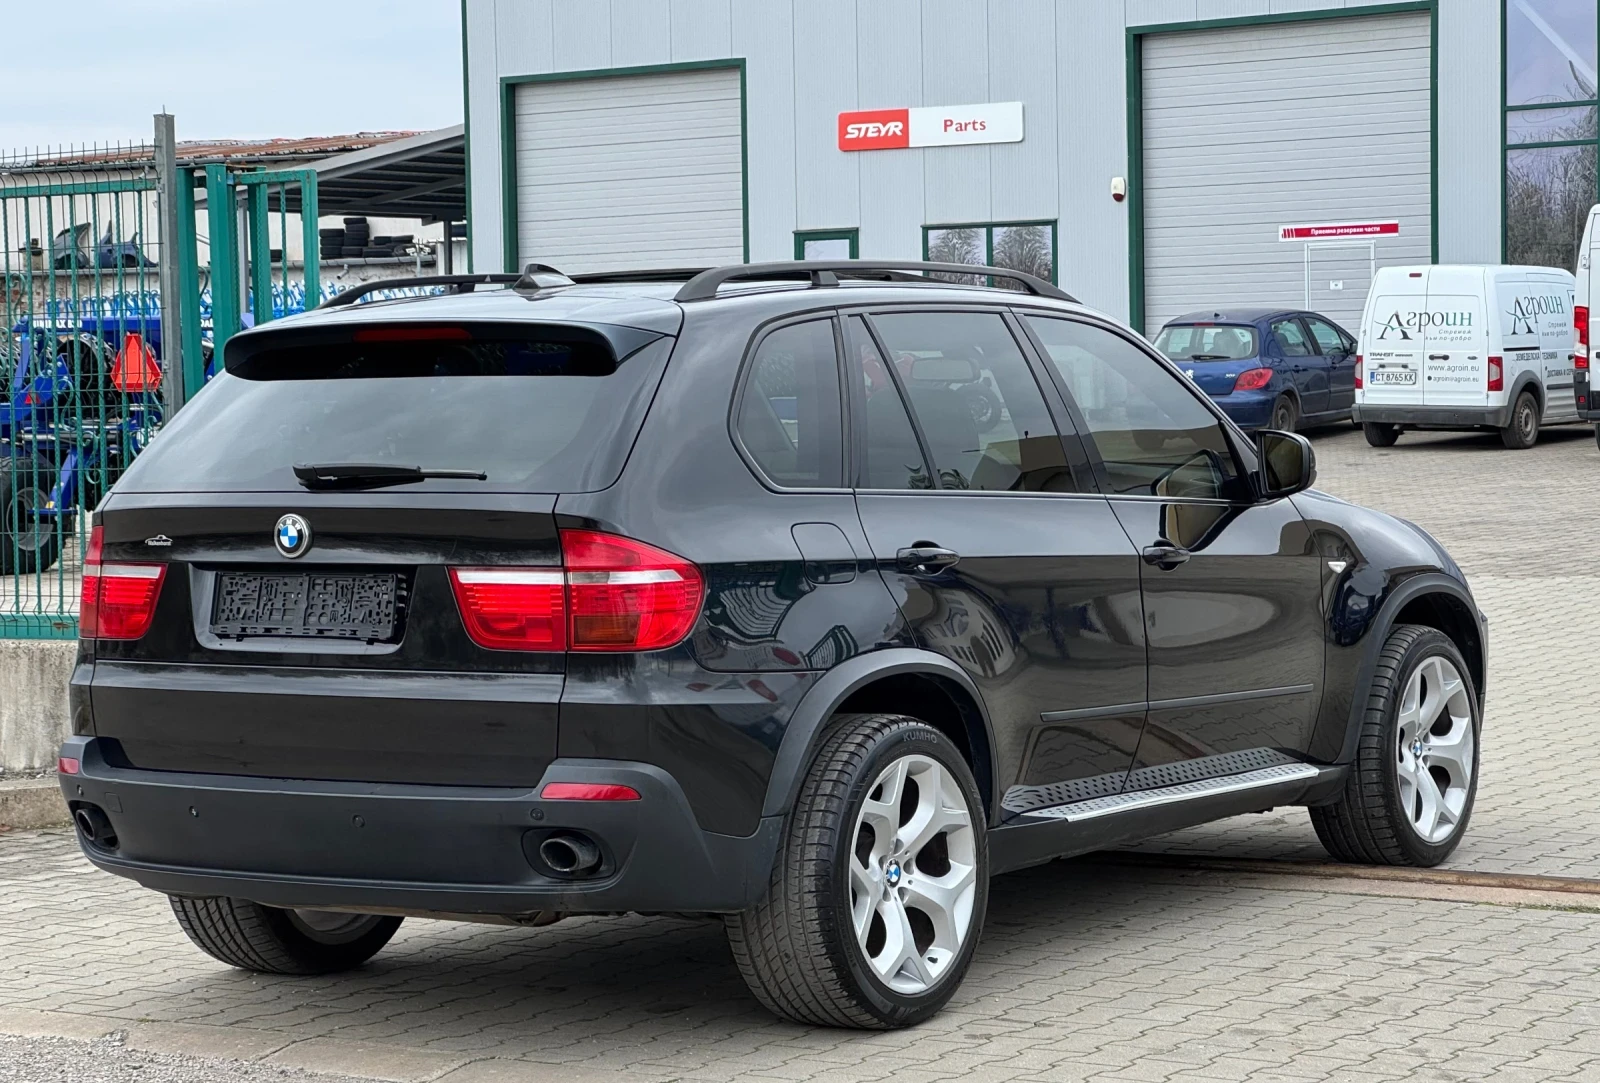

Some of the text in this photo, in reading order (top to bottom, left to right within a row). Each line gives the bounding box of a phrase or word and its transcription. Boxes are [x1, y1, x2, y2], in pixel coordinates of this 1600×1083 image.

[844, 118, 987, 139] STEYR Parts
[1427, 363, 1480, 373] www.agroin.eu
[1386, 373, 1404, 382] 8765
[903, 731, 937, 743] KUMHO
